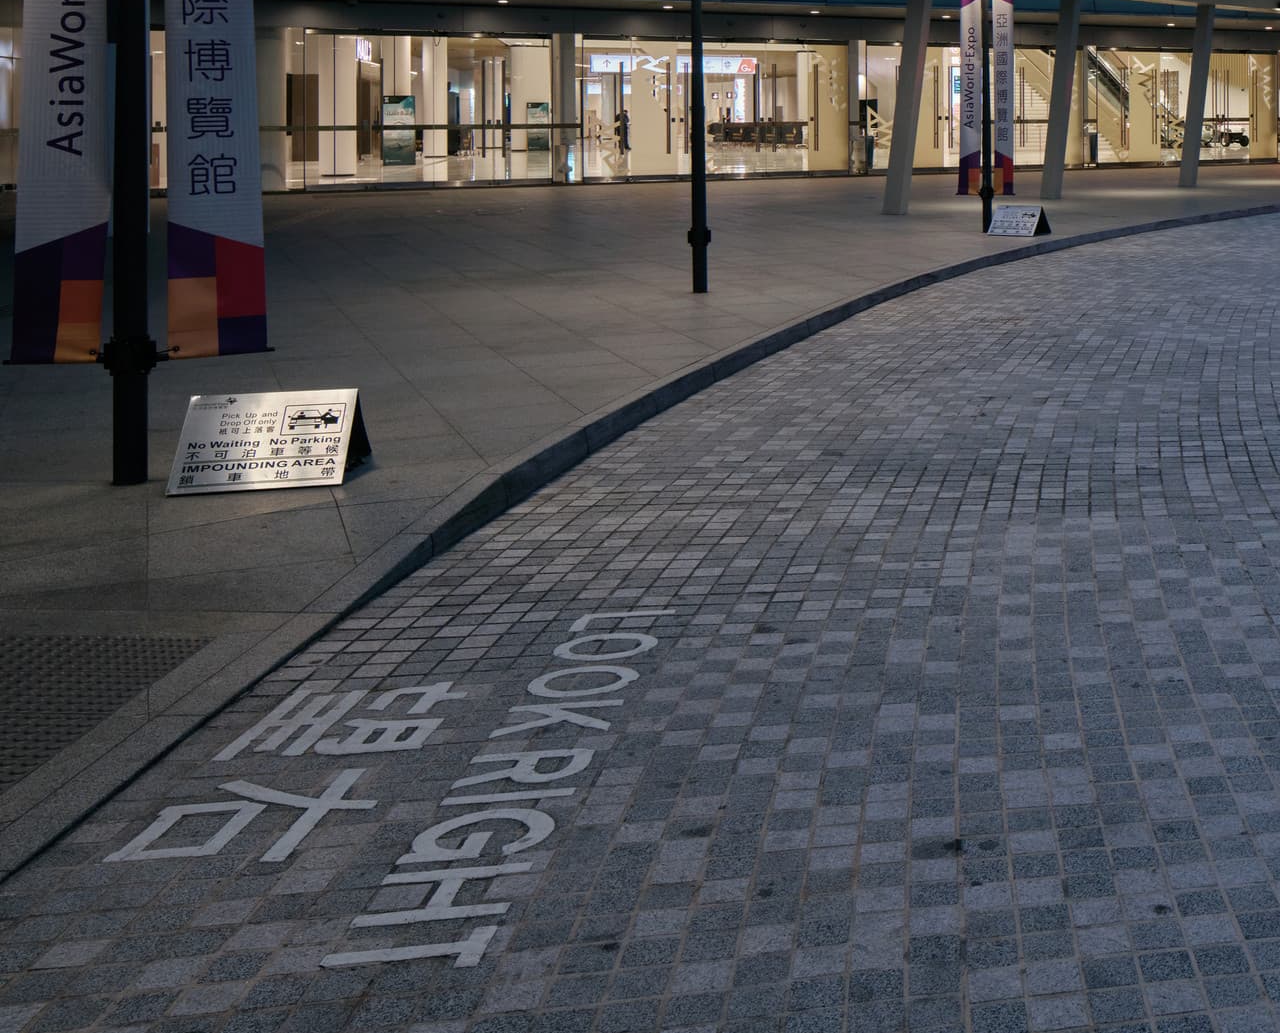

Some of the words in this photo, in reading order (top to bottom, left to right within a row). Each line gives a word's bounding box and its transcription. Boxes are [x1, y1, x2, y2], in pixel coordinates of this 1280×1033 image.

[964, 26, 977, 130] AsiaWorld-Expo
[219, 419, 242, 428] Drop
[258, 418, 278, 426] only
[221, 412, 241, 420] Pick
[245, 411, 258, 419] Up
[187, 441, 207, 451] No
[209, 439, 261, 449] Waiting
[269, 438, 288, 446] No
[290, 435, 342, 445] Parking
[181, 459, 288, 474] IMPOUNDING
[291, 457, 337, 467] AREA
[489, 609, 677, 738] LOOK
[320, 748, 596, 968] RIGHT
